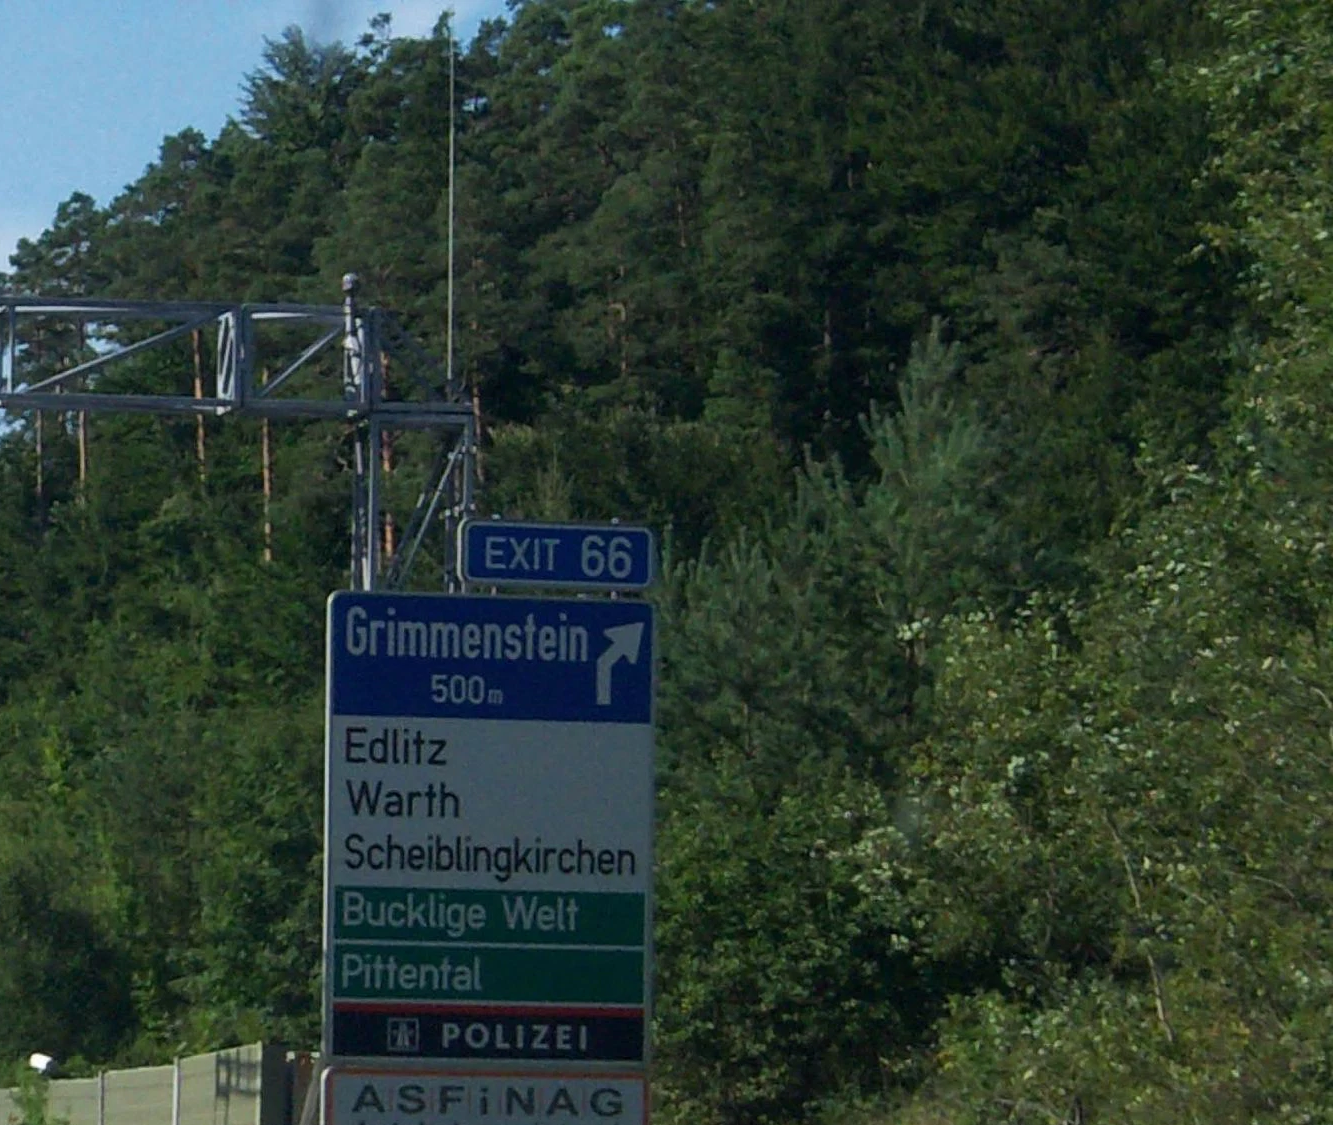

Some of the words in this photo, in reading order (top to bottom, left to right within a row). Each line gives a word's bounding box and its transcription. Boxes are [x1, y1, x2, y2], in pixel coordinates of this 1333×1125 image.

[484, 536, 561, 571] EXIT
[581, 535, 632, 578] 66
[345, 605, 589, 662] Grimmenstein
[345, 727, 447, 765] Edlitz
[346, 780, 460, 818] Warth
[344, 834, 635, 882] Scheiblingkirchen
[342, 891, 486, 938] Bucklige
[502, 895, 580, 932] Welt
[341, 953, 482, 992] Pittental
[441, 1021, 588, 1052] POLIZEI
